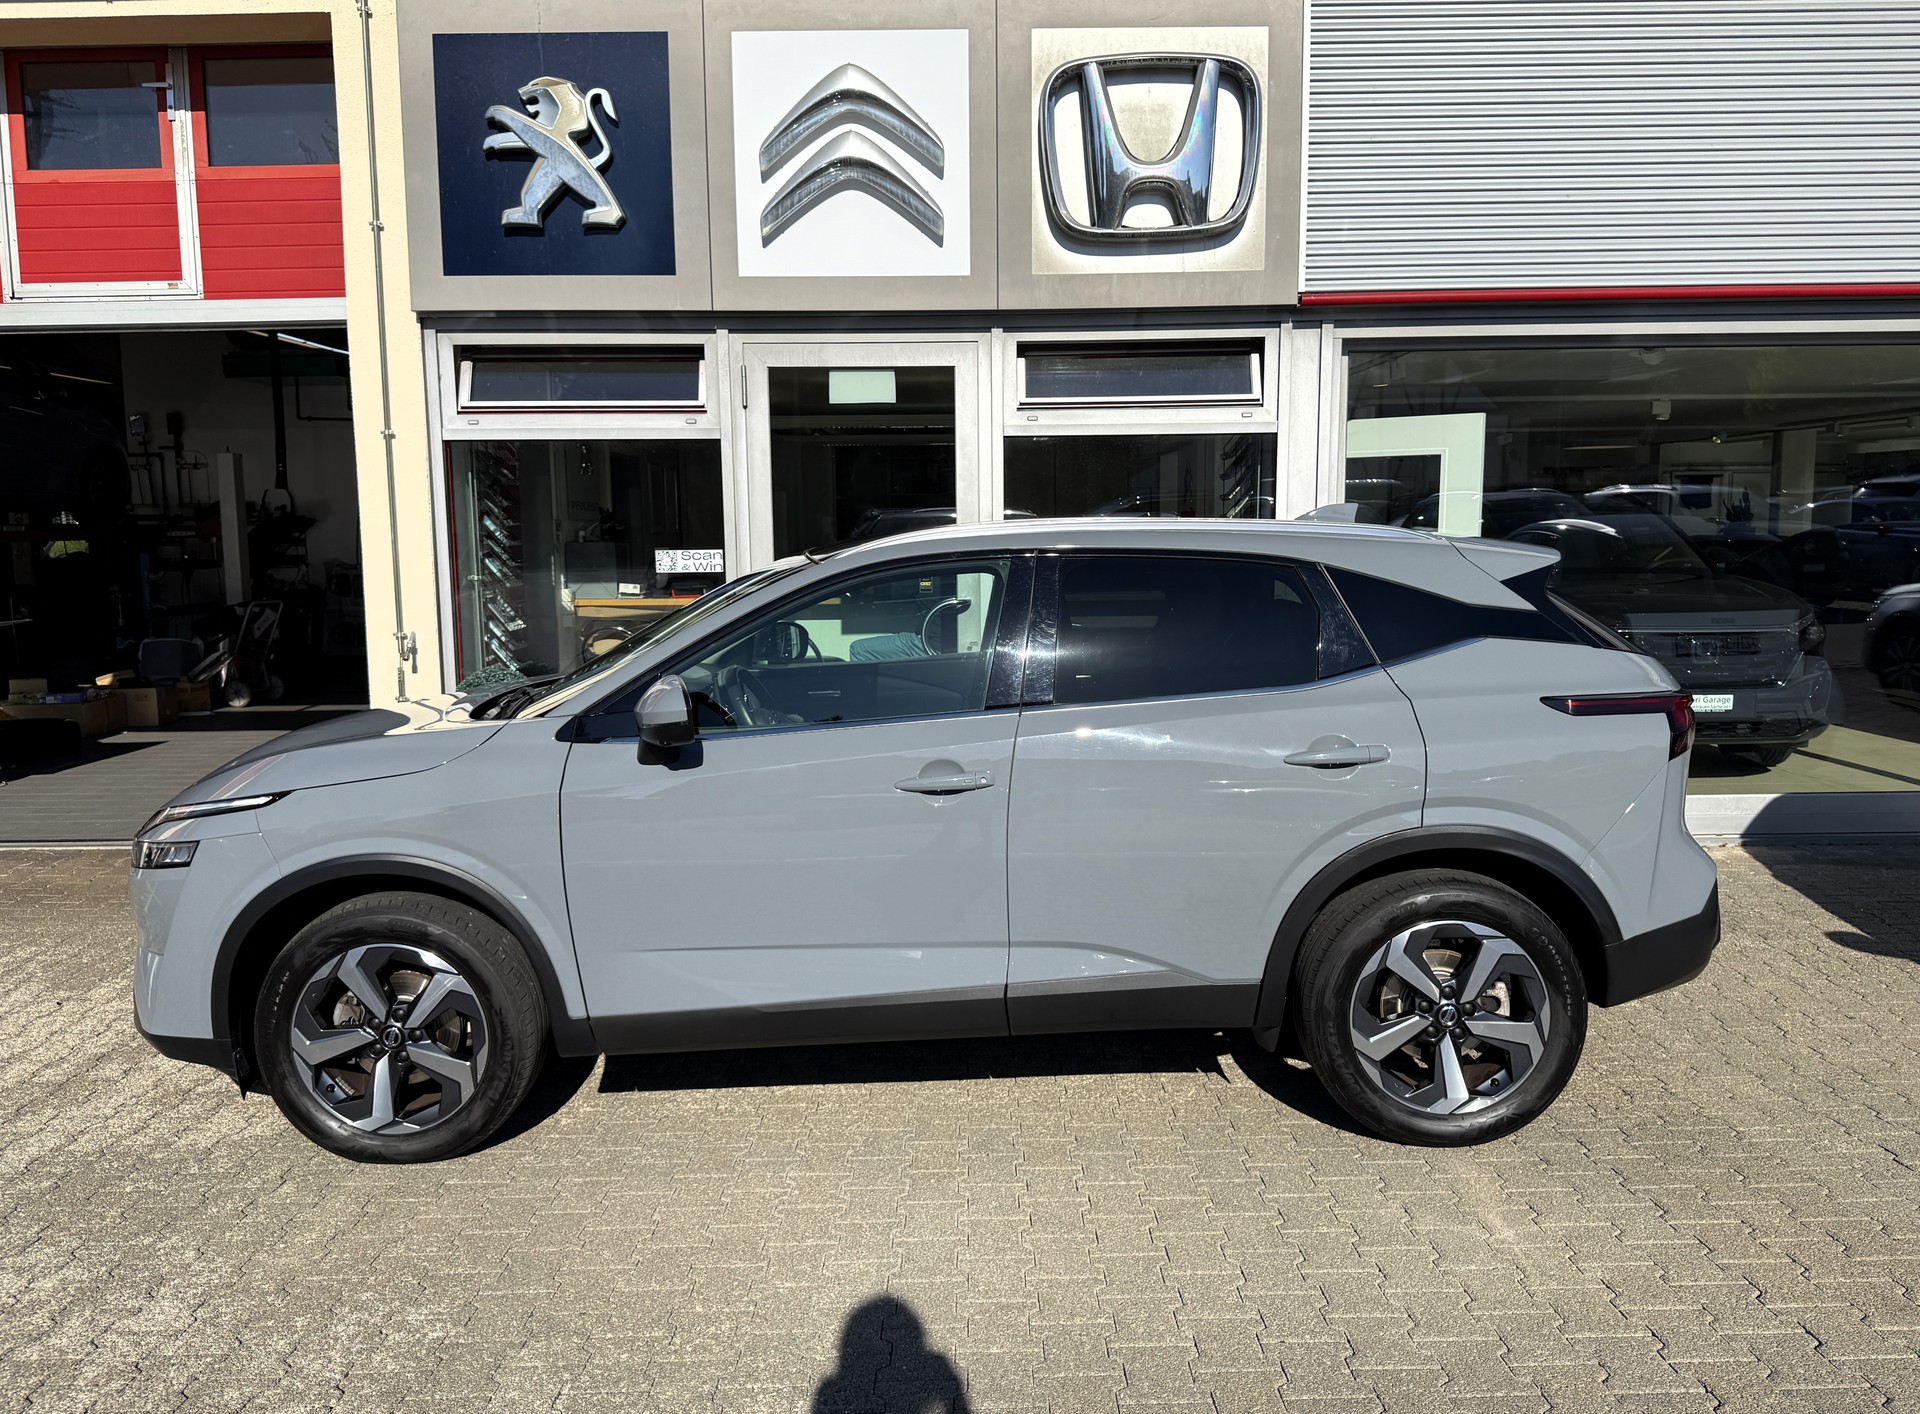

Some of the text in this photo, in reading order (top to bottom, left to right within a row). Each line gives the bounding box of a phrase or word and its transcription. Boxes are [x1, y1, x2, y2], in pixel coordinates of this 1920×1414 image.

[681, 551, 723, 560] Scan
[681, 561, 723, 571] & Win
[1703, 696, 1731, 705] Garage
